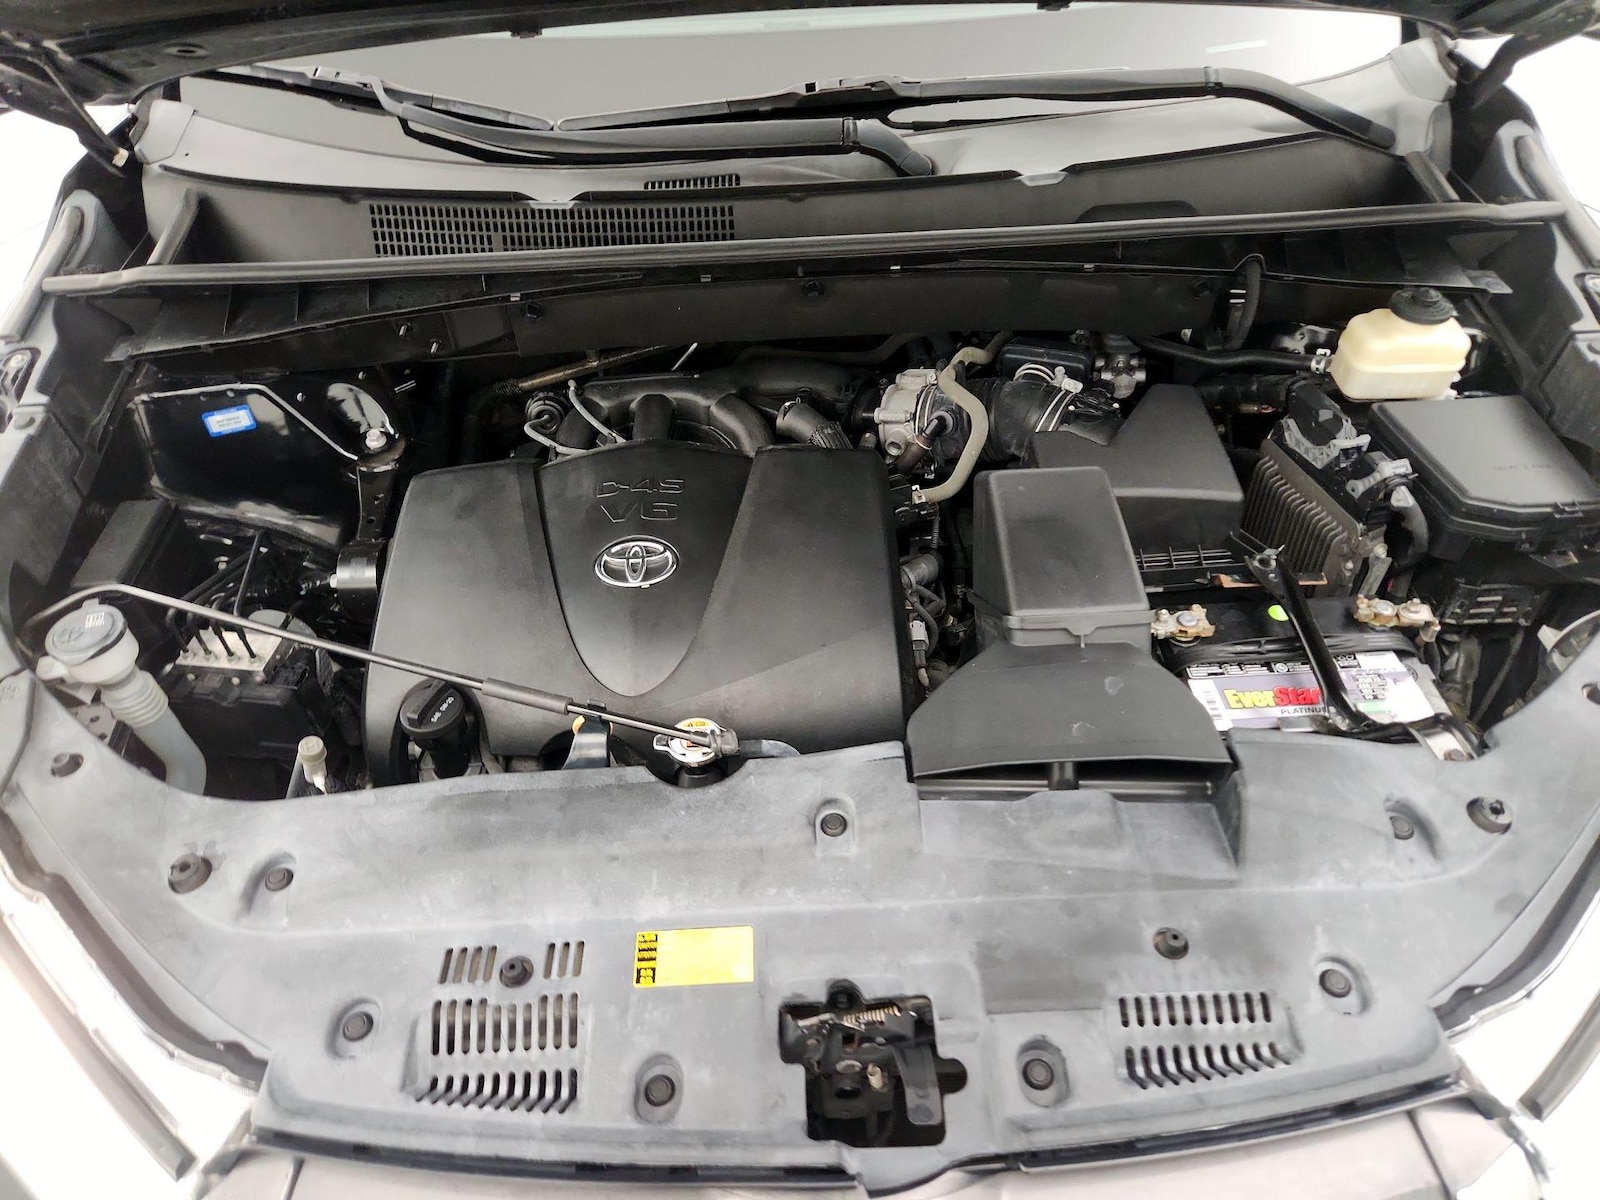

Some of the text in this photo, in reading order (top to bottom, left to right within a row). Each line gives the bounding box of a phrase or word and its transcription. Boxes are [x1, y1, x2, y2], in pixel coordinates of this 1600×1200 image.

[596, 478, 684, 498] D-4S
[600, 501, 678, 523] V6
[1223, 685, 1322, 710] EverStar
